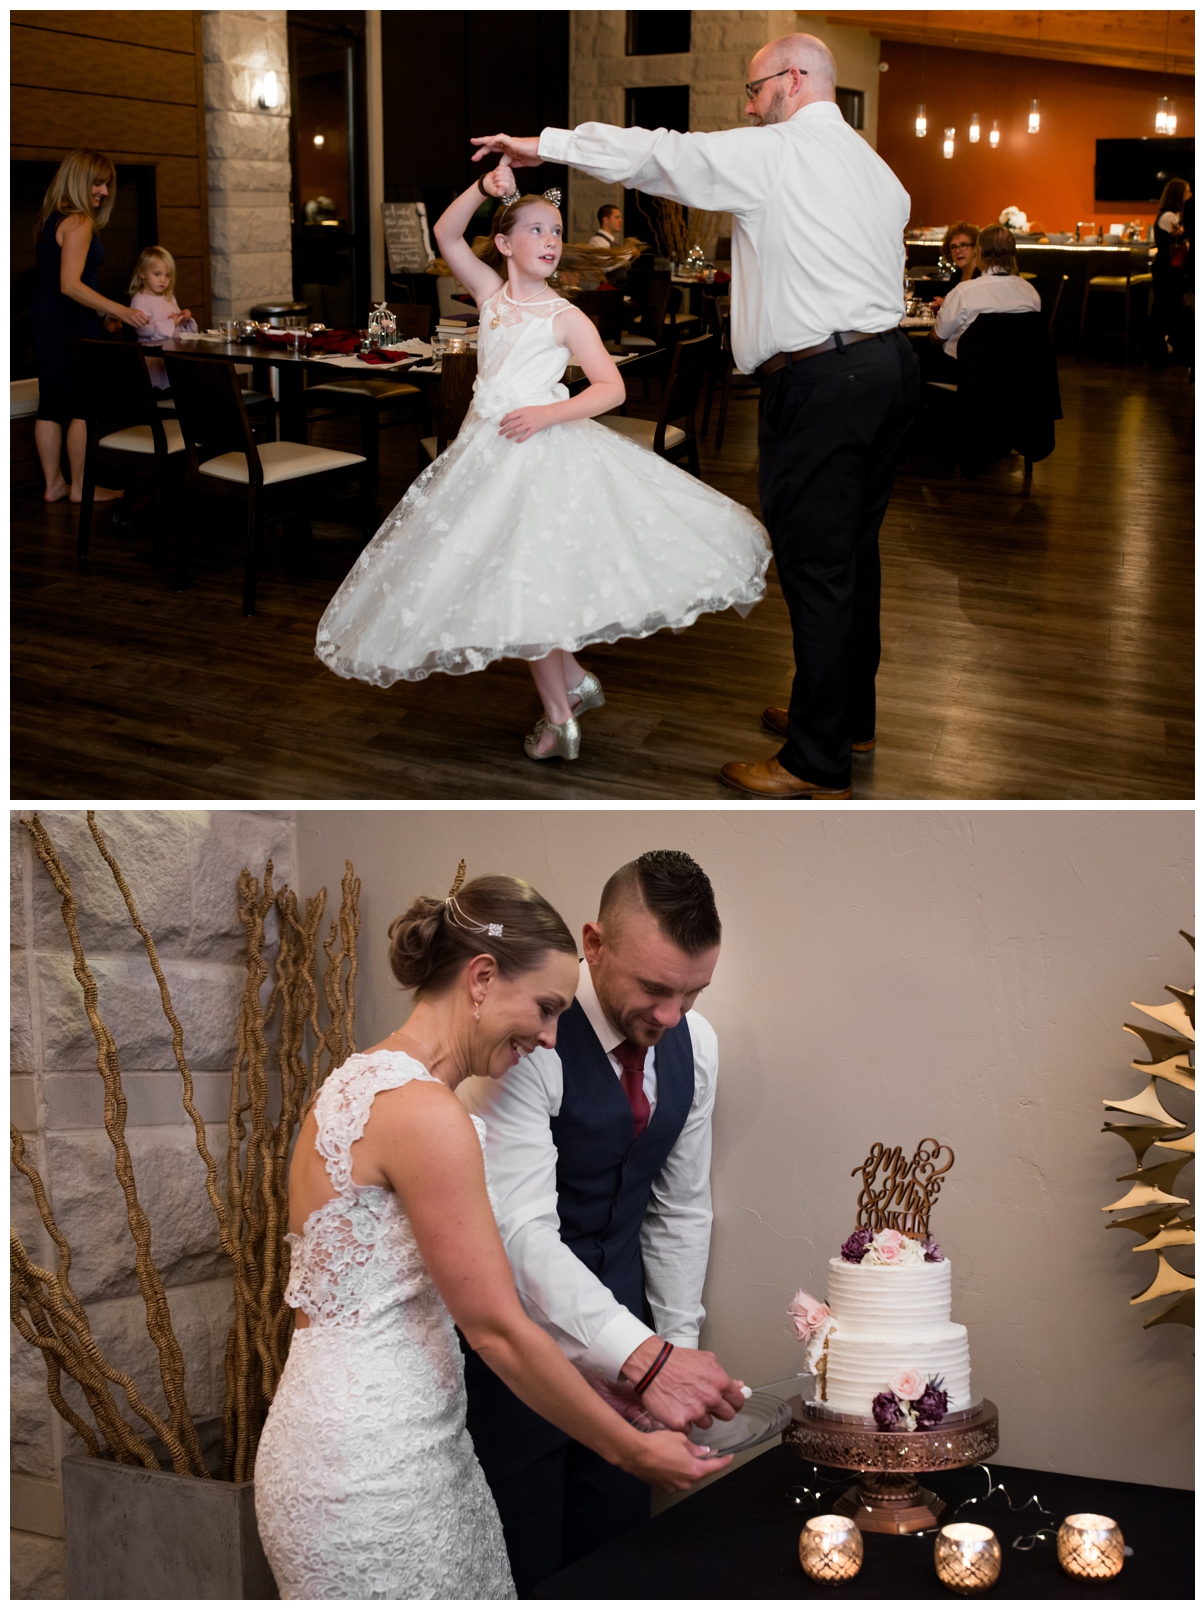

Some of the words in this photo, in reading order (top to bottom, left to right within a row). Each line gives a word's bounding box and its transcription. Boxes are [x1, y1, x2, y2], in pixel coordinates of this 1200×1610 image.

[851, 1141, 911, 1181] Mr
[878, 1170, 938, 1216] Mrs
[855, 1207, 931, 1235] CONKLIN
